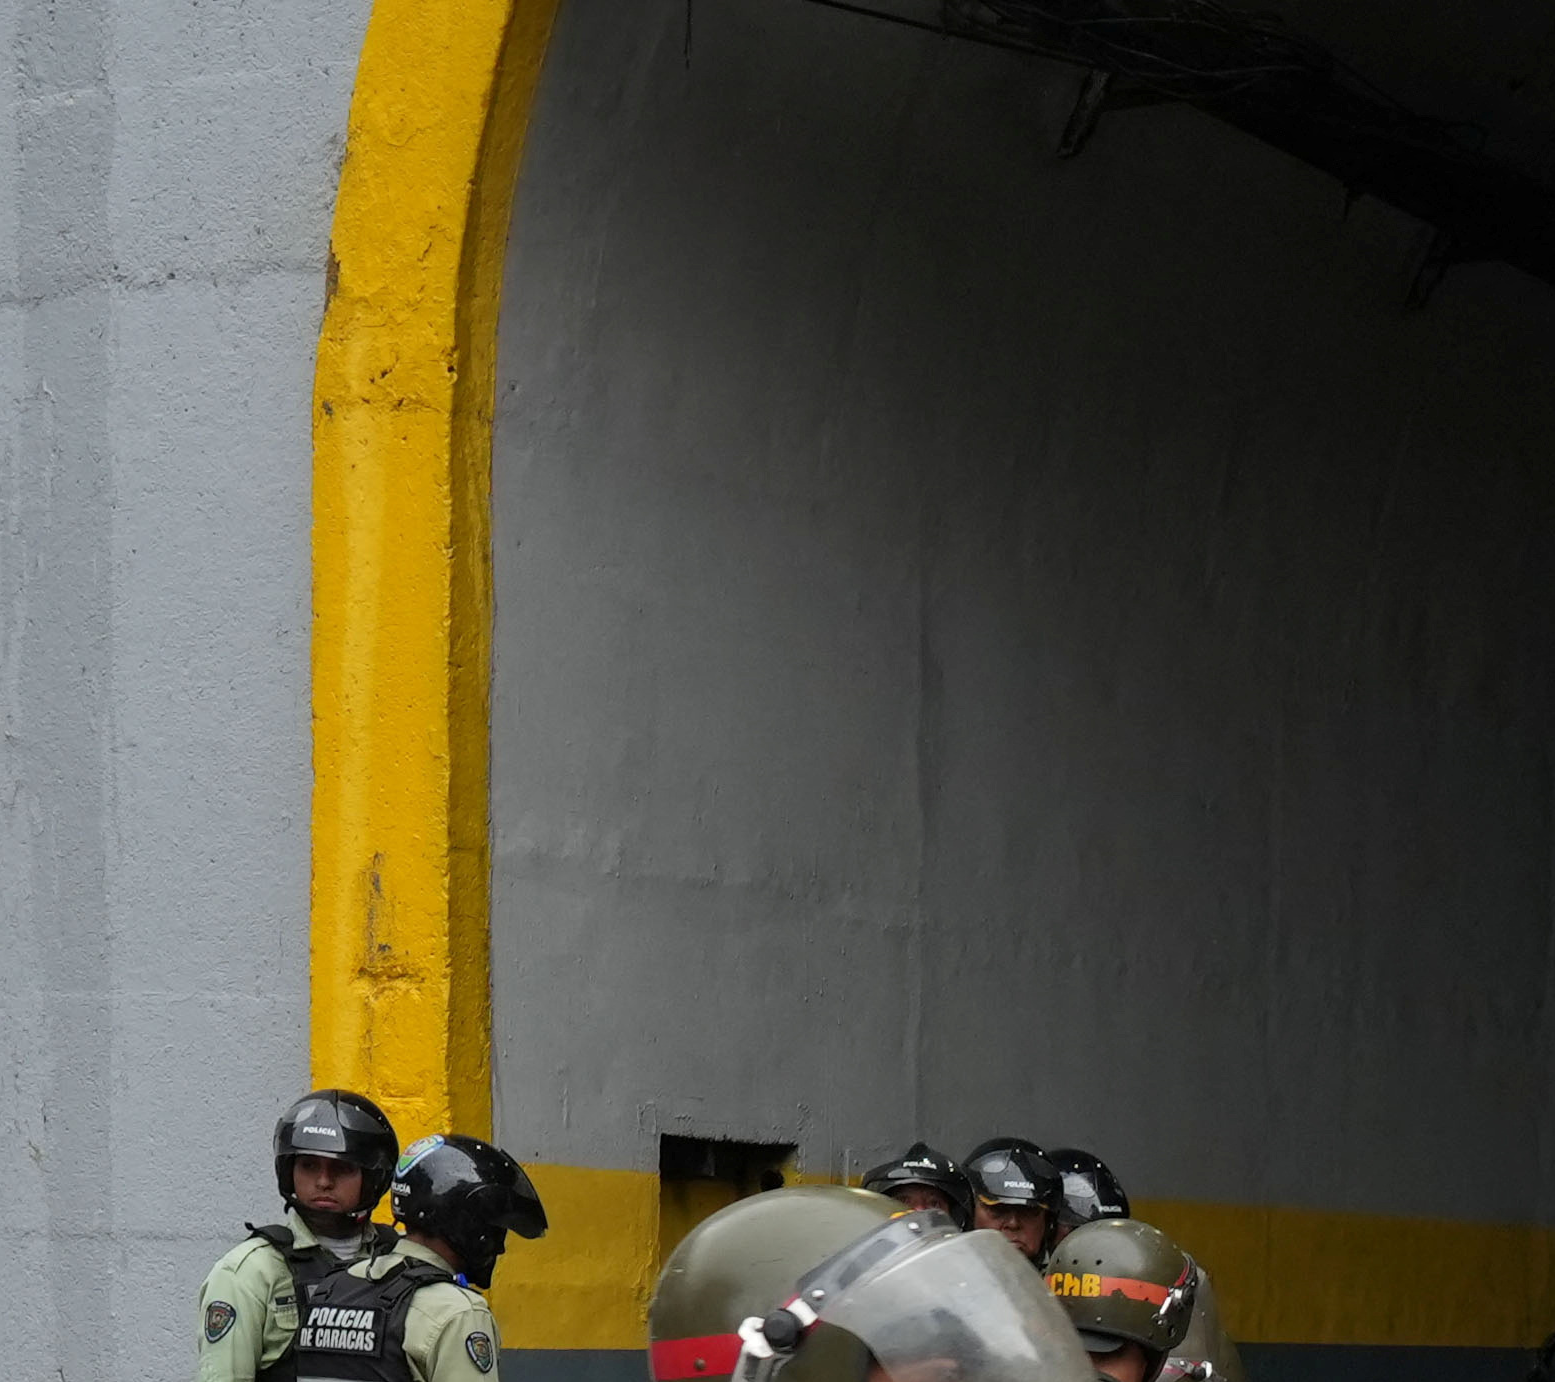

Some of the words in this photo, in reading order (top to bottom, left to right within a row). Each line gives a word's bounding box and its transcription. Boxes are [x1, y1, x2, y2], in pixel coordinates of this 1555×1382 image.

[307, 1306, 375, 1330] POLICIA
[300, 1327, 314, 1347] DE
[315, 1327, 376, 1352] CARACAS
